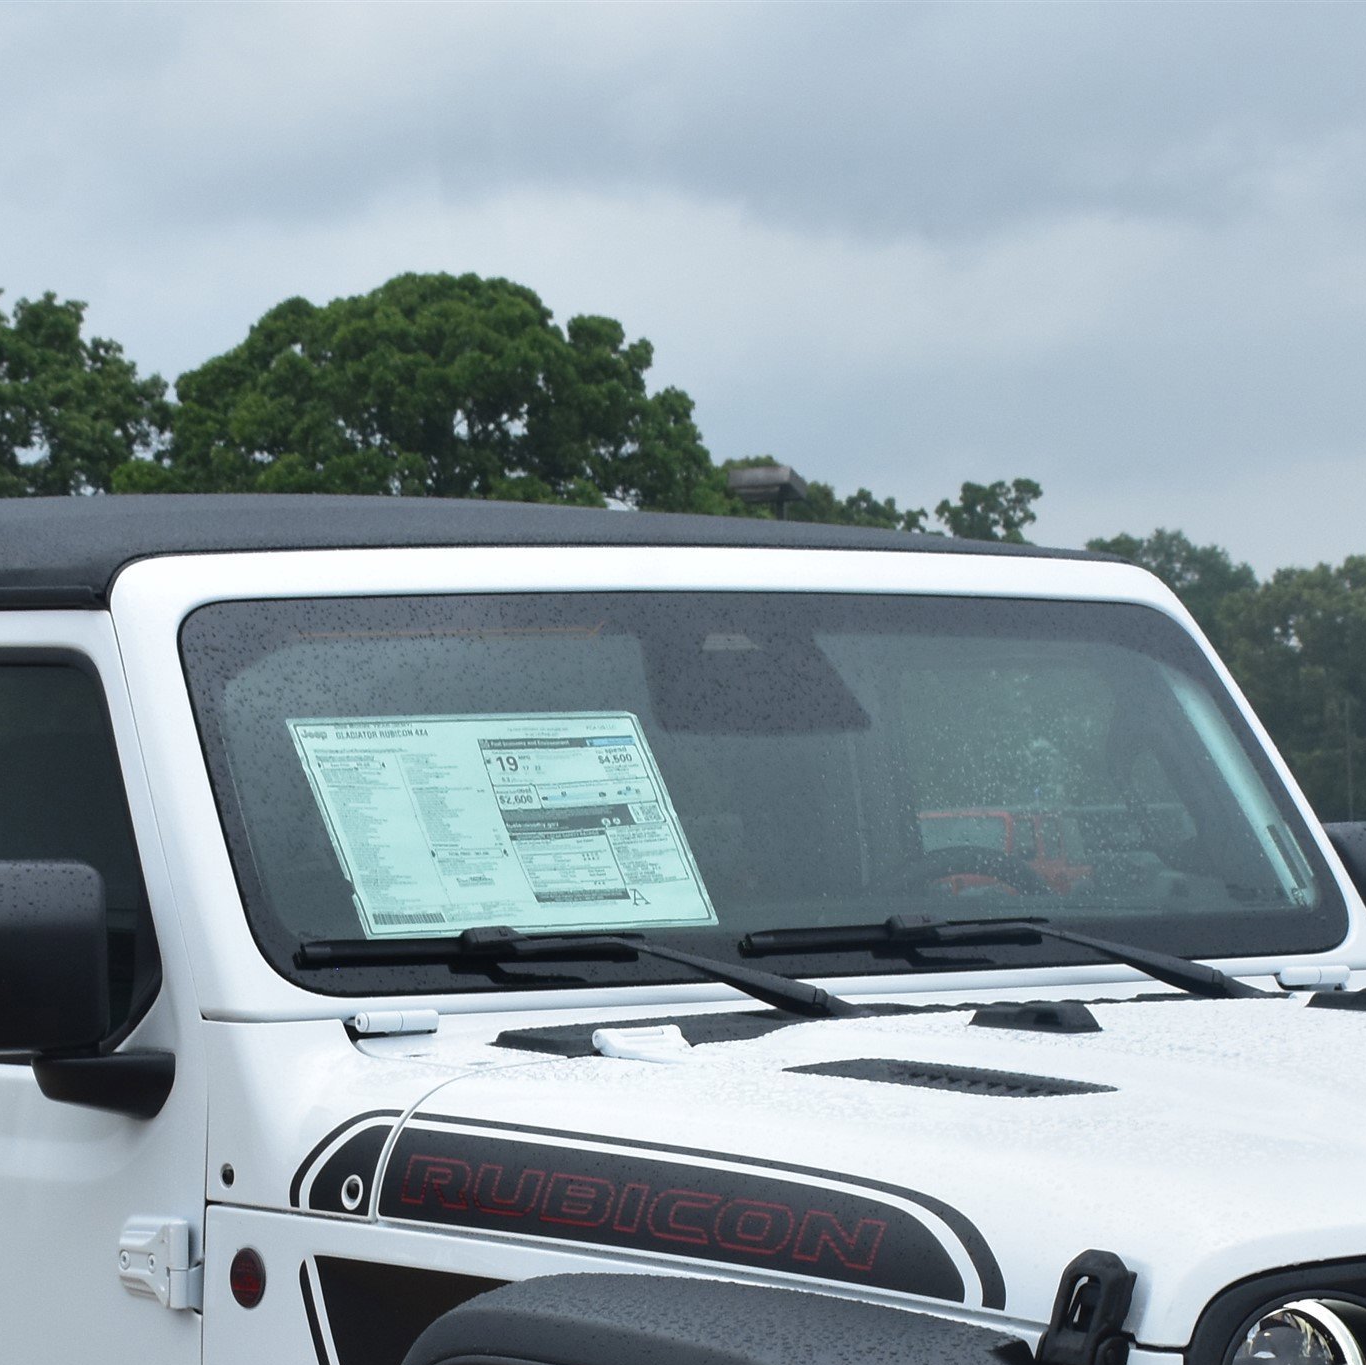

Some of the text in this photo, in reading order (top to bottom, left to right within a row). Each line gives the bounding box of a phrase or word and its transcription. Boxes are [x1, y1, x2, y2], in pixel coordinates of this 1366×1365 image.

[336, 730, 378, 739] GLADIATOR
[380, 729, 413, 738] RUBICON
[496, 756, 518, 772] 19
[598, 754, 632, 764] $4,500
[499, 795, 533, 805] $2,600
[401, 1154, 887, 1271] RUBICON
